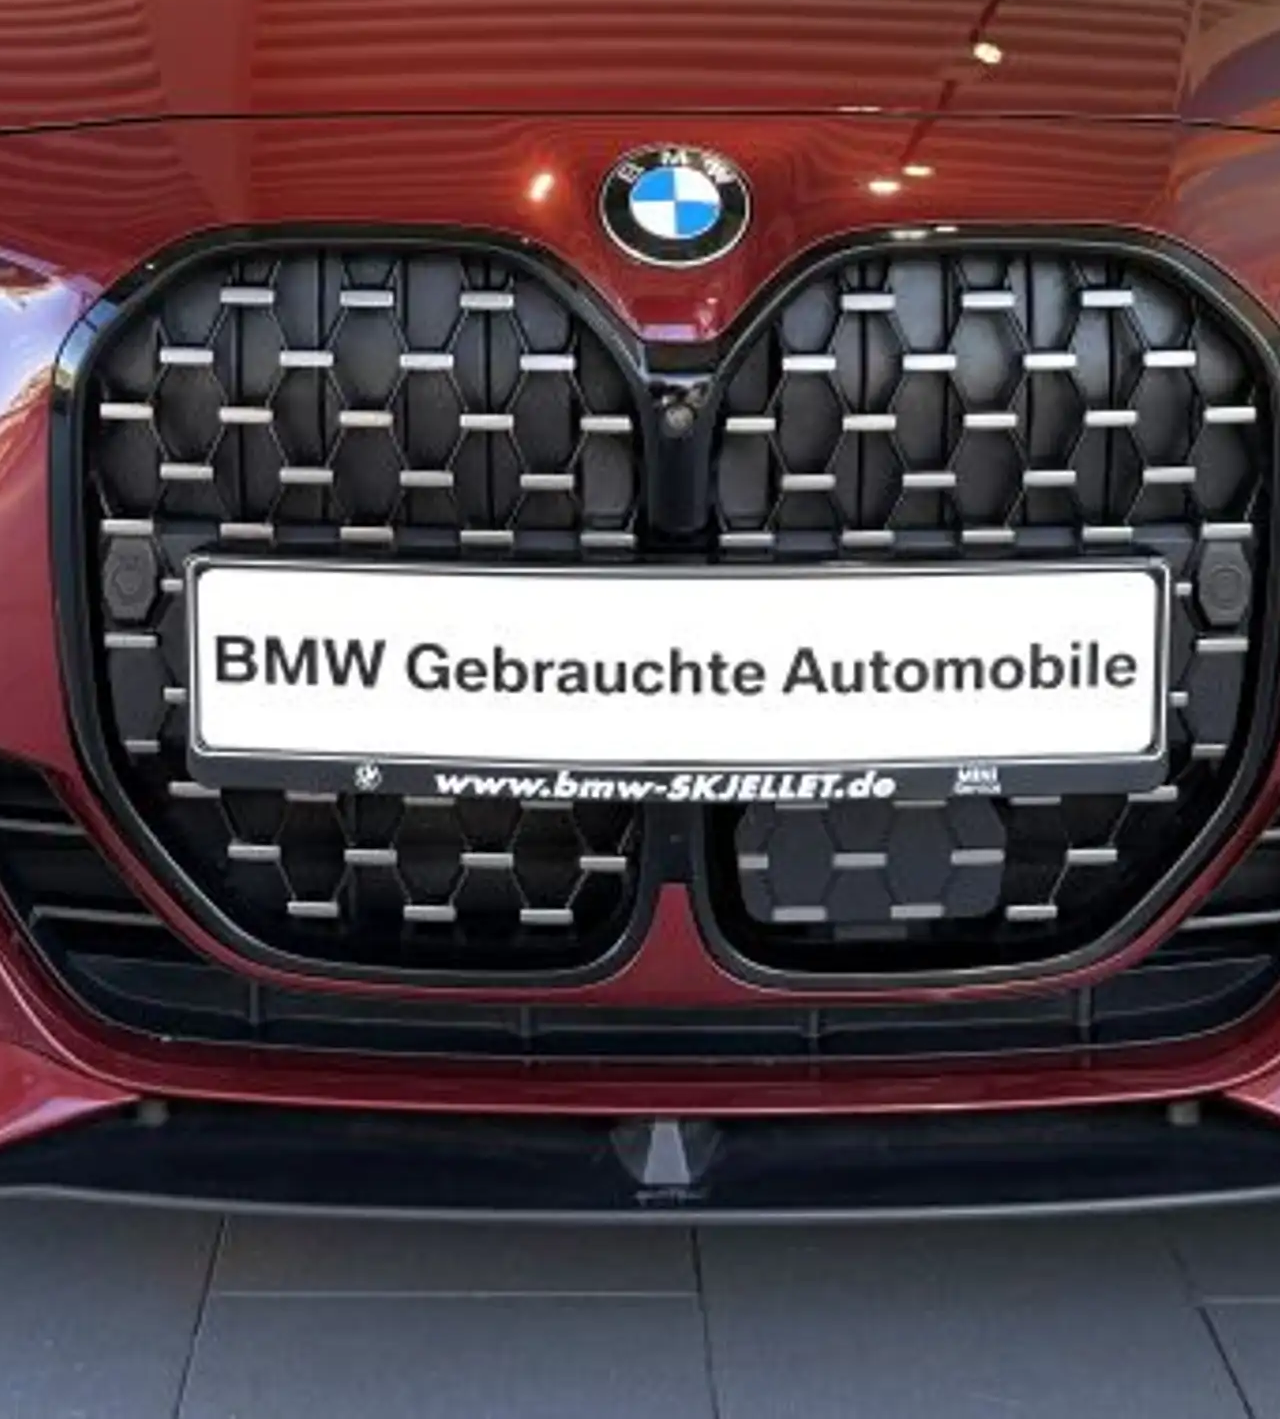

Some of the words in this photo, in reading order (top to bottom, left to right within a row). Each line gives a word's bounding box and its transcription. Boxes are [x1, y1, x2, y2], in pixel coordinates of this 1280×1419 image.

[616, 148, 738, 184] BMW
[214, 634, 387, 689] BMW
[405, 642, 767, 696] Gebrauchte
[781, 641, 1138, 695] Automobile
[434, 771, 897, 801] www.bmw-SKJELLET.de
